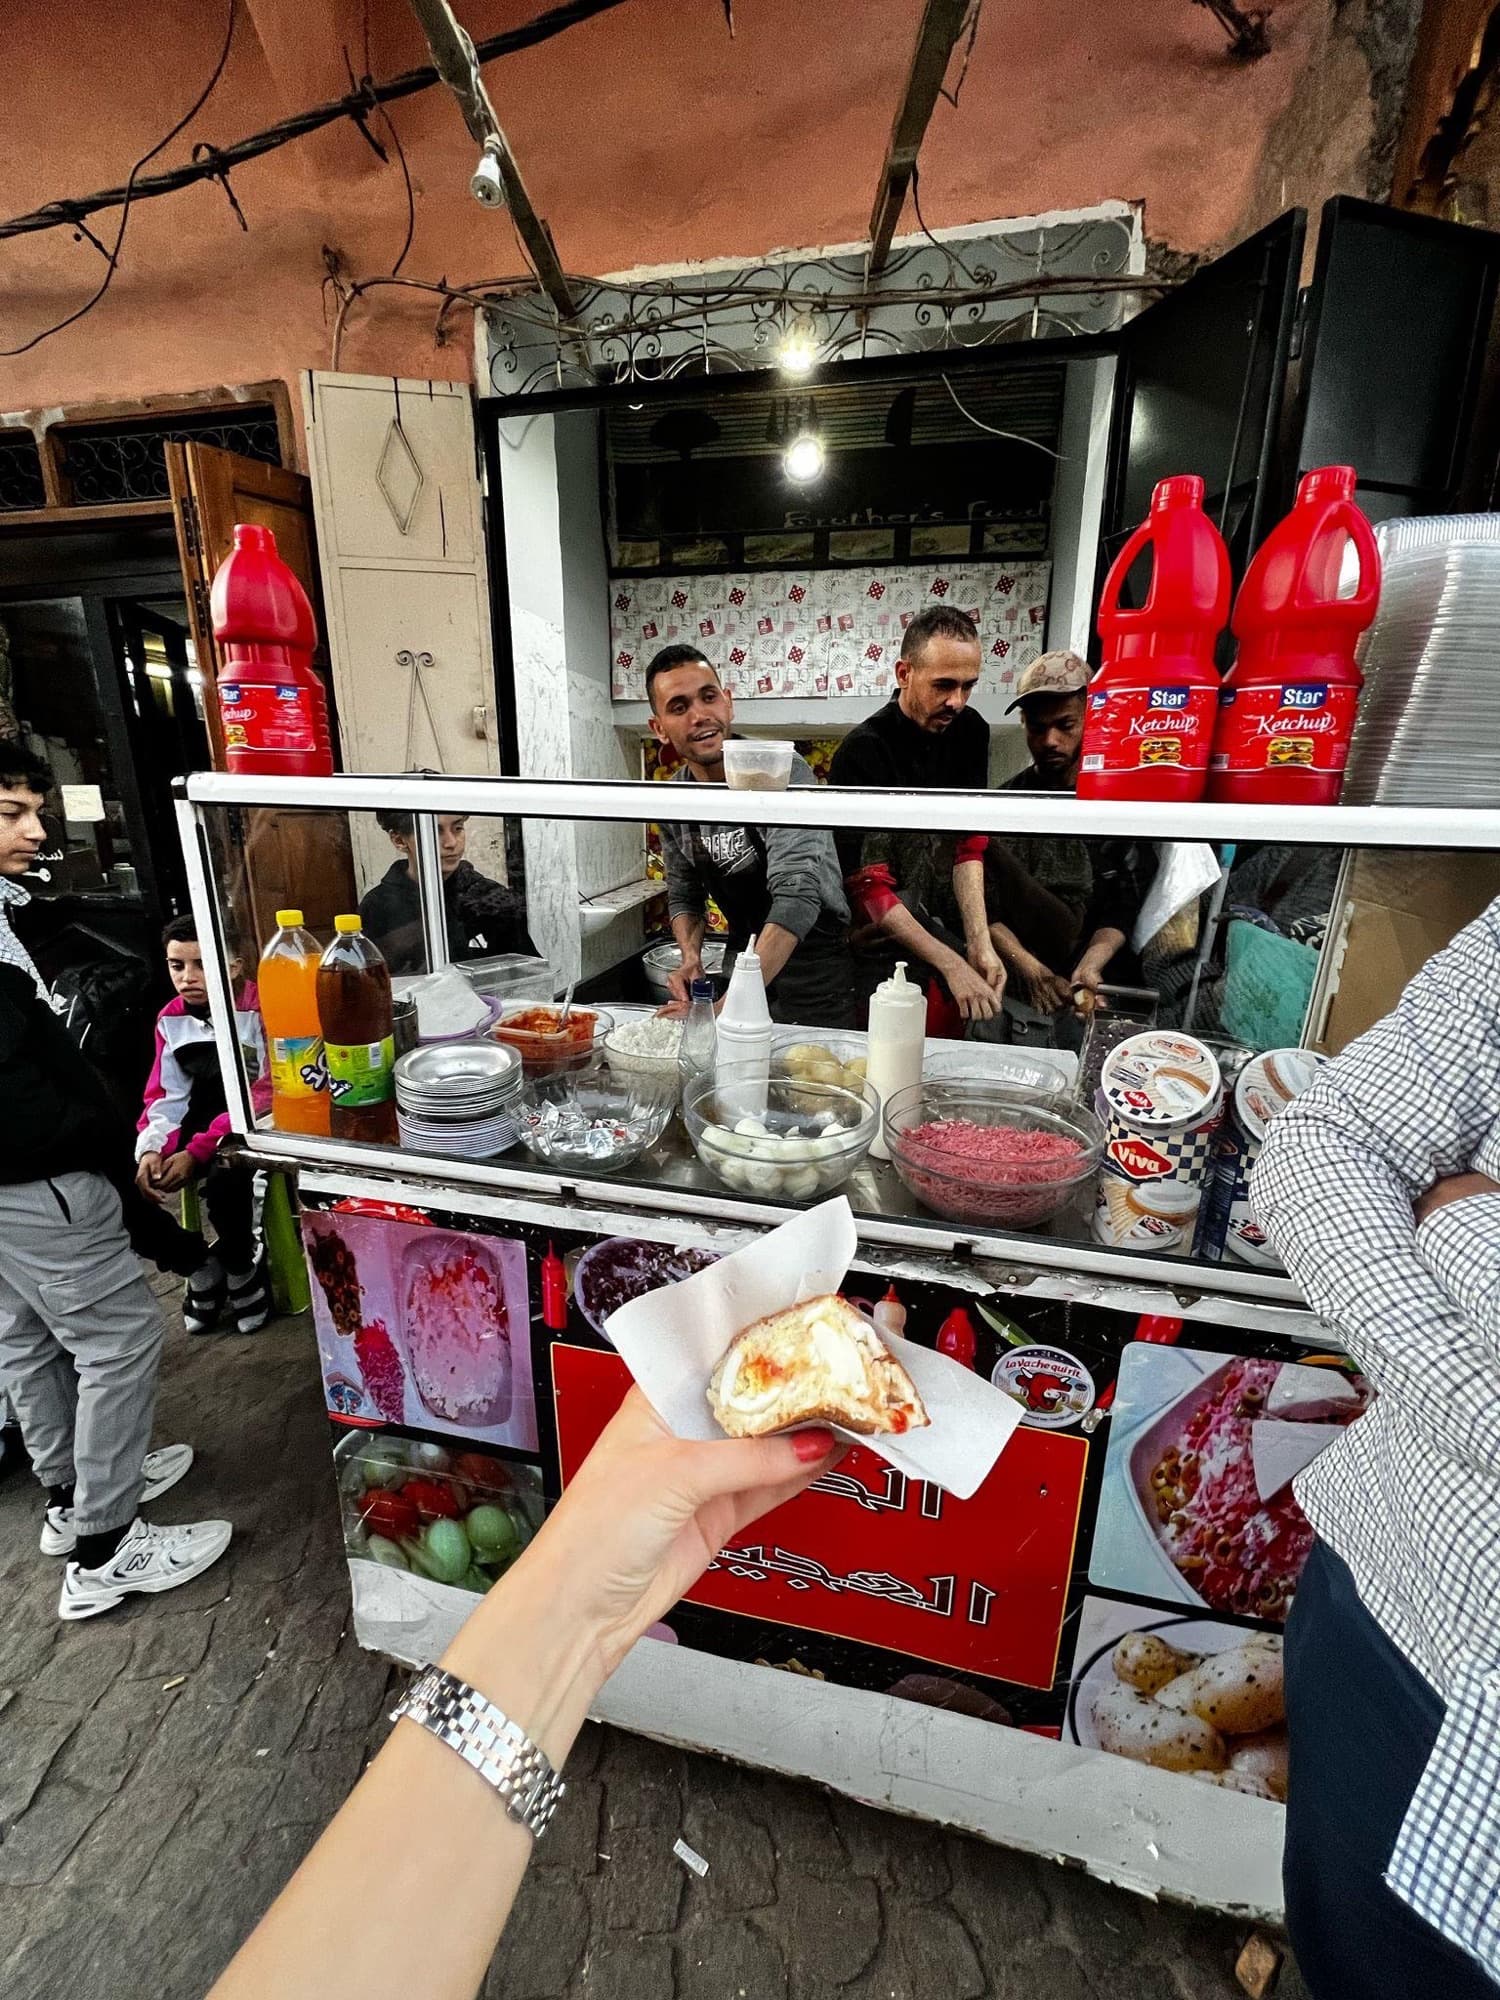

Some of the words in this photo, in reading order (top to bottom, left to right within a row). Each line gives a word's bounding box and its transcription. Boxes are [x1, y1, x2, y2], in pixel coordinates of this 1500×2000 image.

[1151, 690, 1186, 706] Star
[1283, 688, 1323, 706] Star
[1128, 714, 1196, 736] Ketchup
[1257, 712, 1334, 736] Ketchup
[1117, 1143, 1160, 1173] Viva
[1051, 1364, 1068, 1373] qui
[1068, 1368, 1082, 1378] rit
[126, 1553, 153, 1571] N
